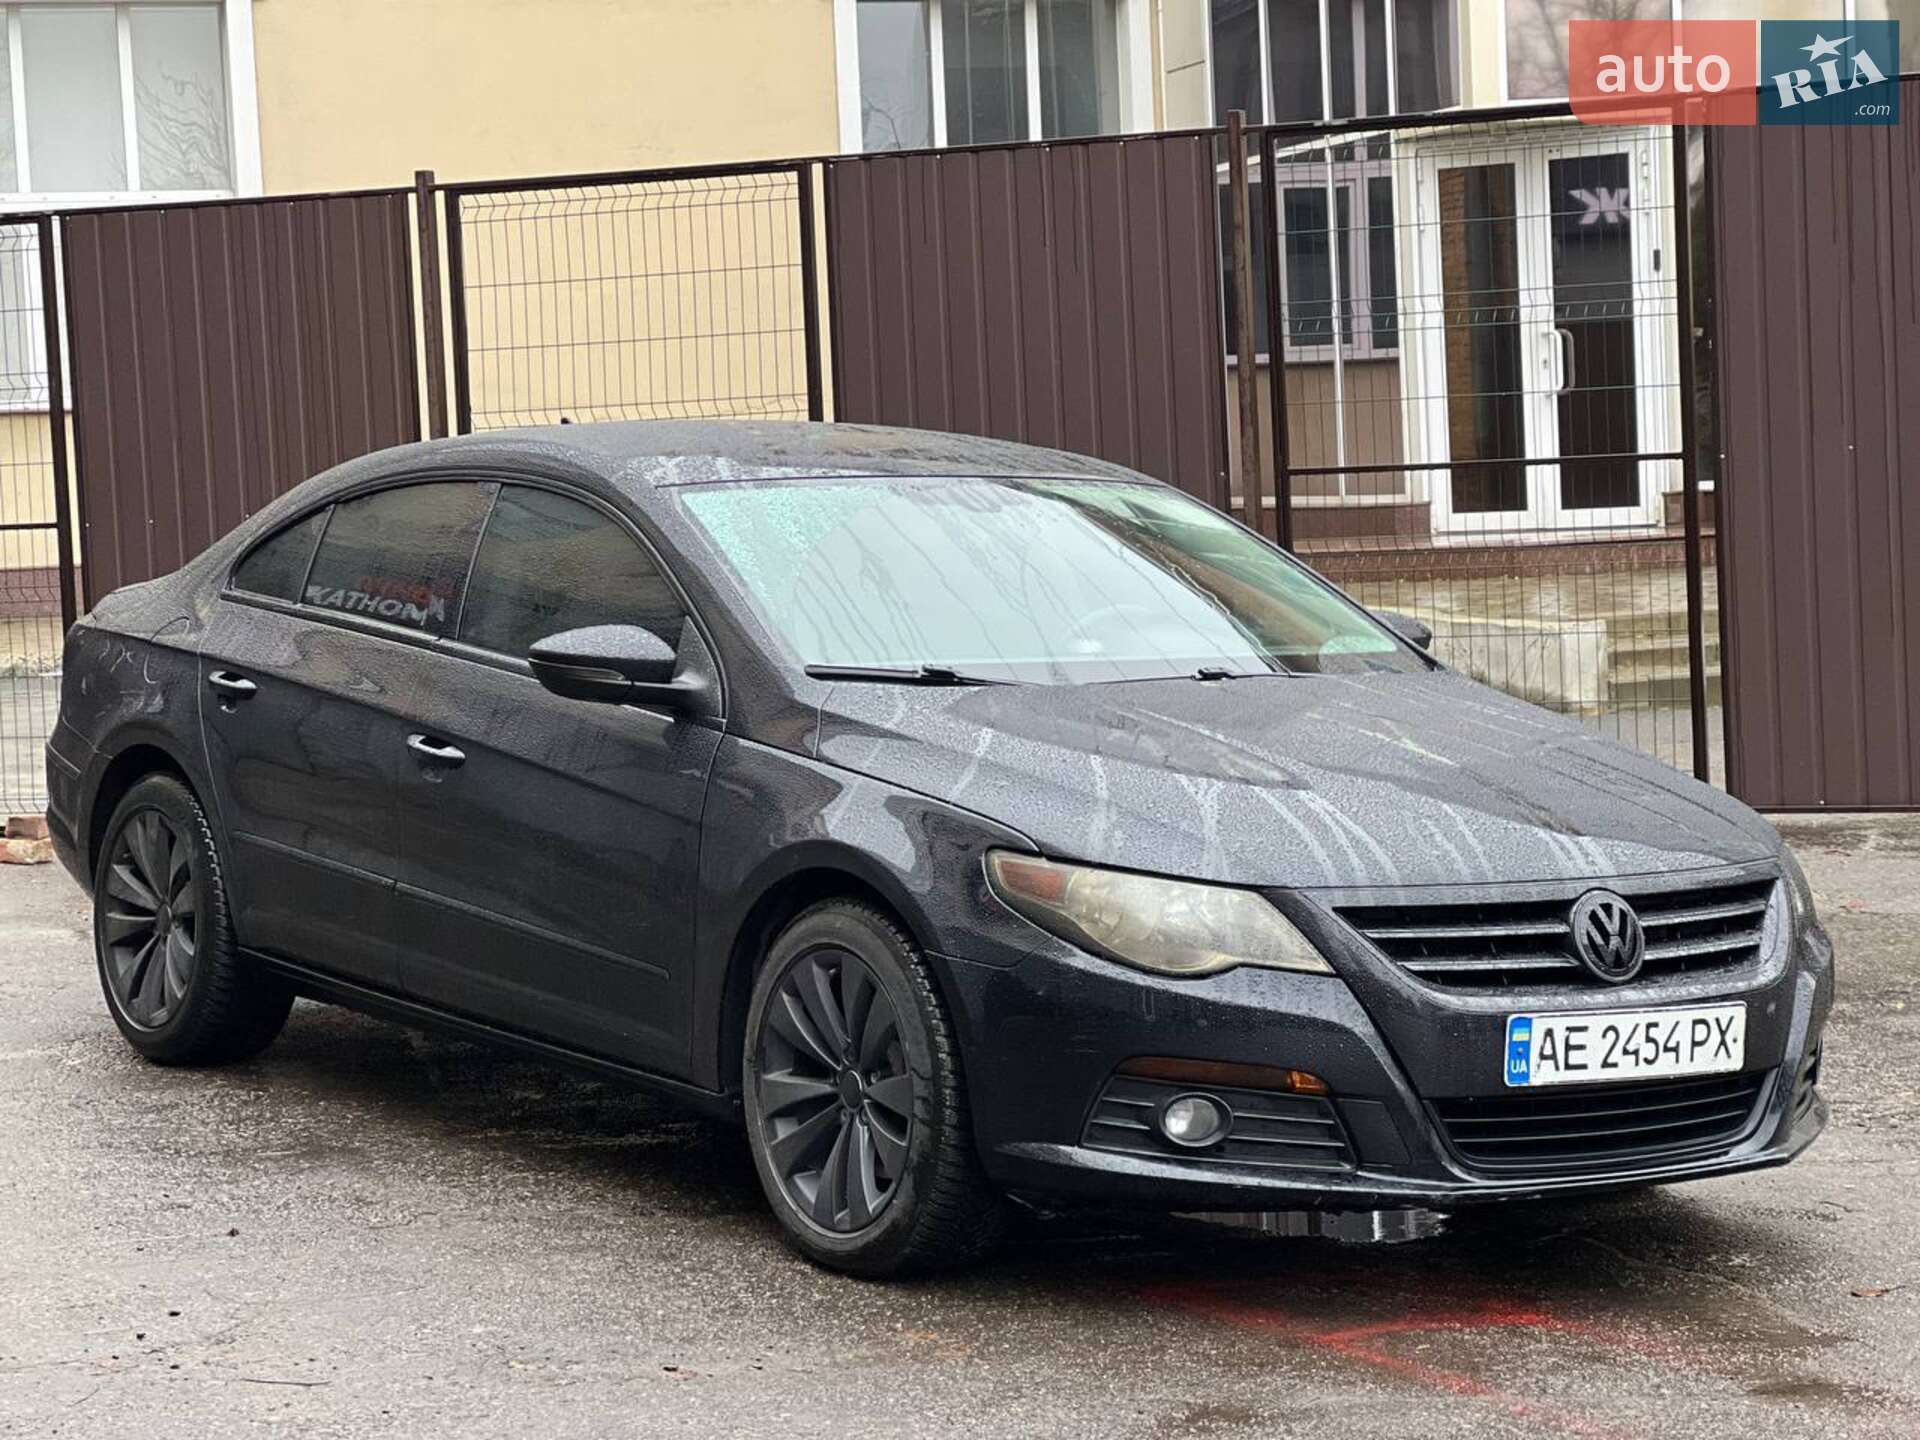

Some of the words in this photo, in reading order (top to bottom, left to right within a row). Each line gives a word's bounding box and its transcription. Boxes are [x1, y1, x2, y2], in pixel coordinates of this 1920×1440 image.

[1536, 1025, 1589, 1072] AE
[1600, 1020, 1681, 1069] 2454
[1690, 1015, 1735, 1062] PX
[1510, 1058, 1528, 1074] UA
